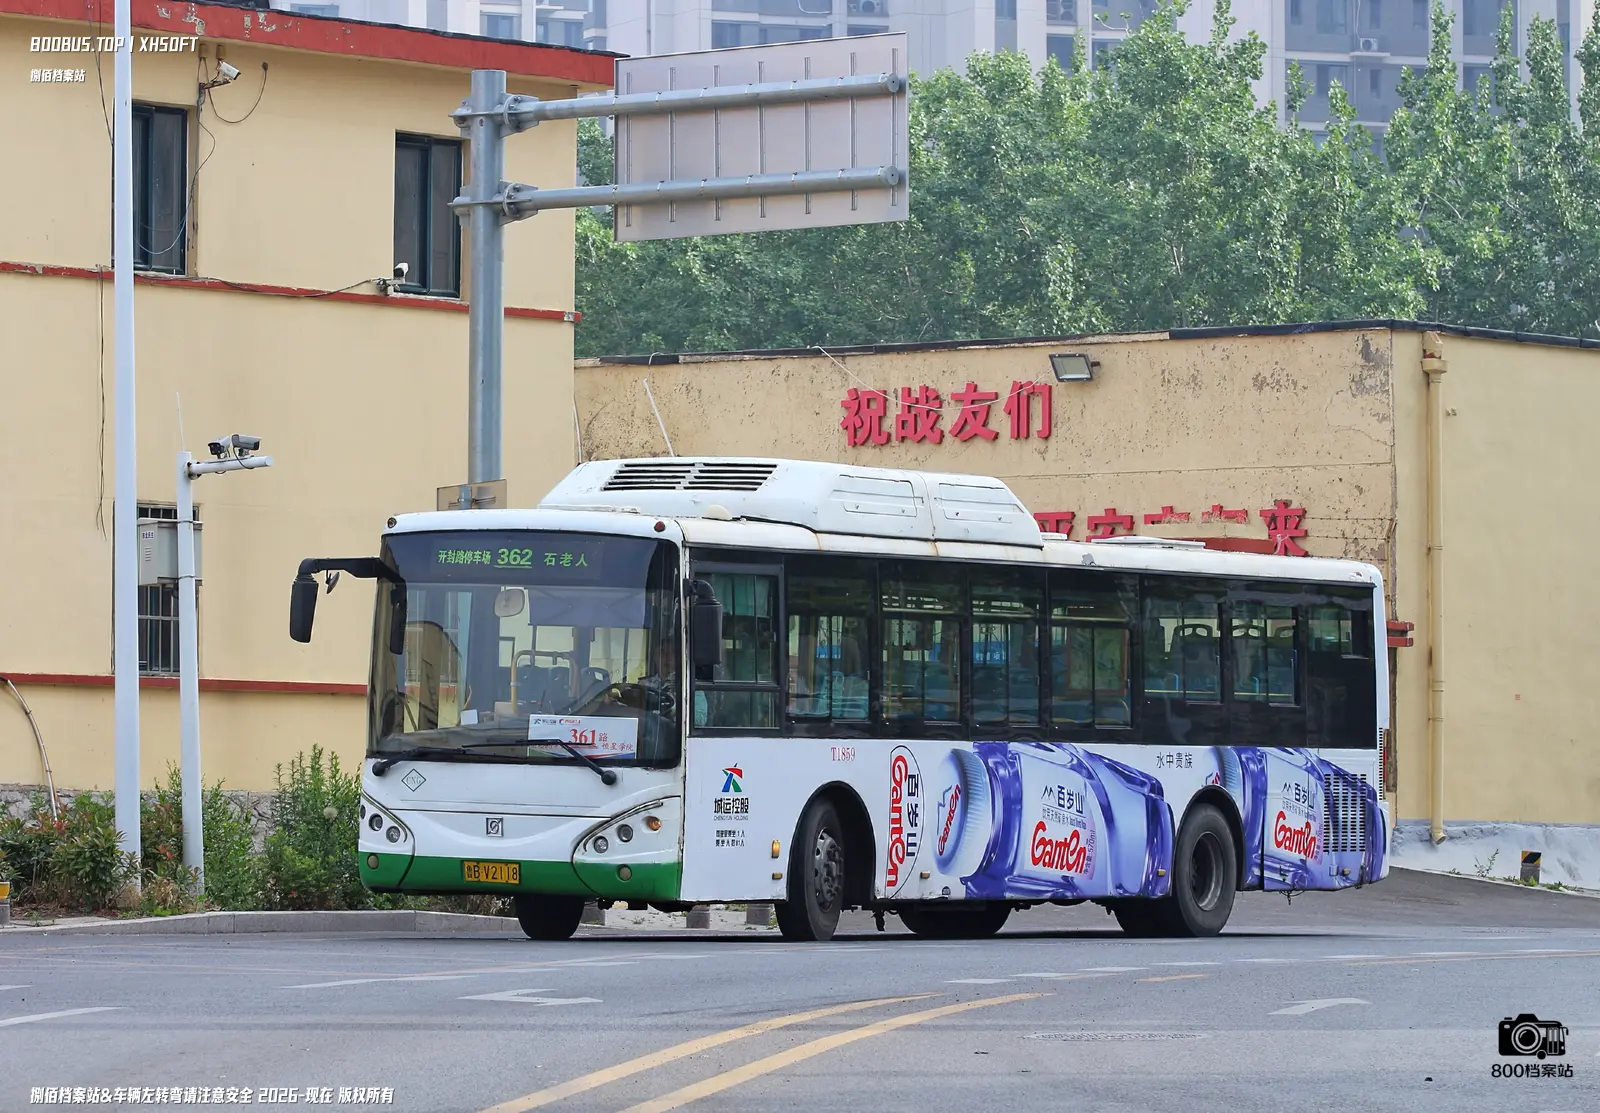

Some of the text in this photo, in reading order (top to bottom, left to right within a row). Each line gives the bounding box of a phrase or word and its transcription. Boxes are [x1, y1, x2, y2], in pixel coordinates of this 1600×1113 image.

[840, 380, 1052, 447] 祝战友们
[438, 548, 588, 567] 开封路停车场 362 石老人
[568, 728, 598, 748] 361
[831, 747, 856, 761] T1859
[1156, 752, 1193, 768] 水中贵族
[406, 776, 421, 785] CNG
[714, 798, 749, 814] 城运控股
[1057, 785, 1084, 814] 百岁山
[906, 774, 919, 857] 百岁山
